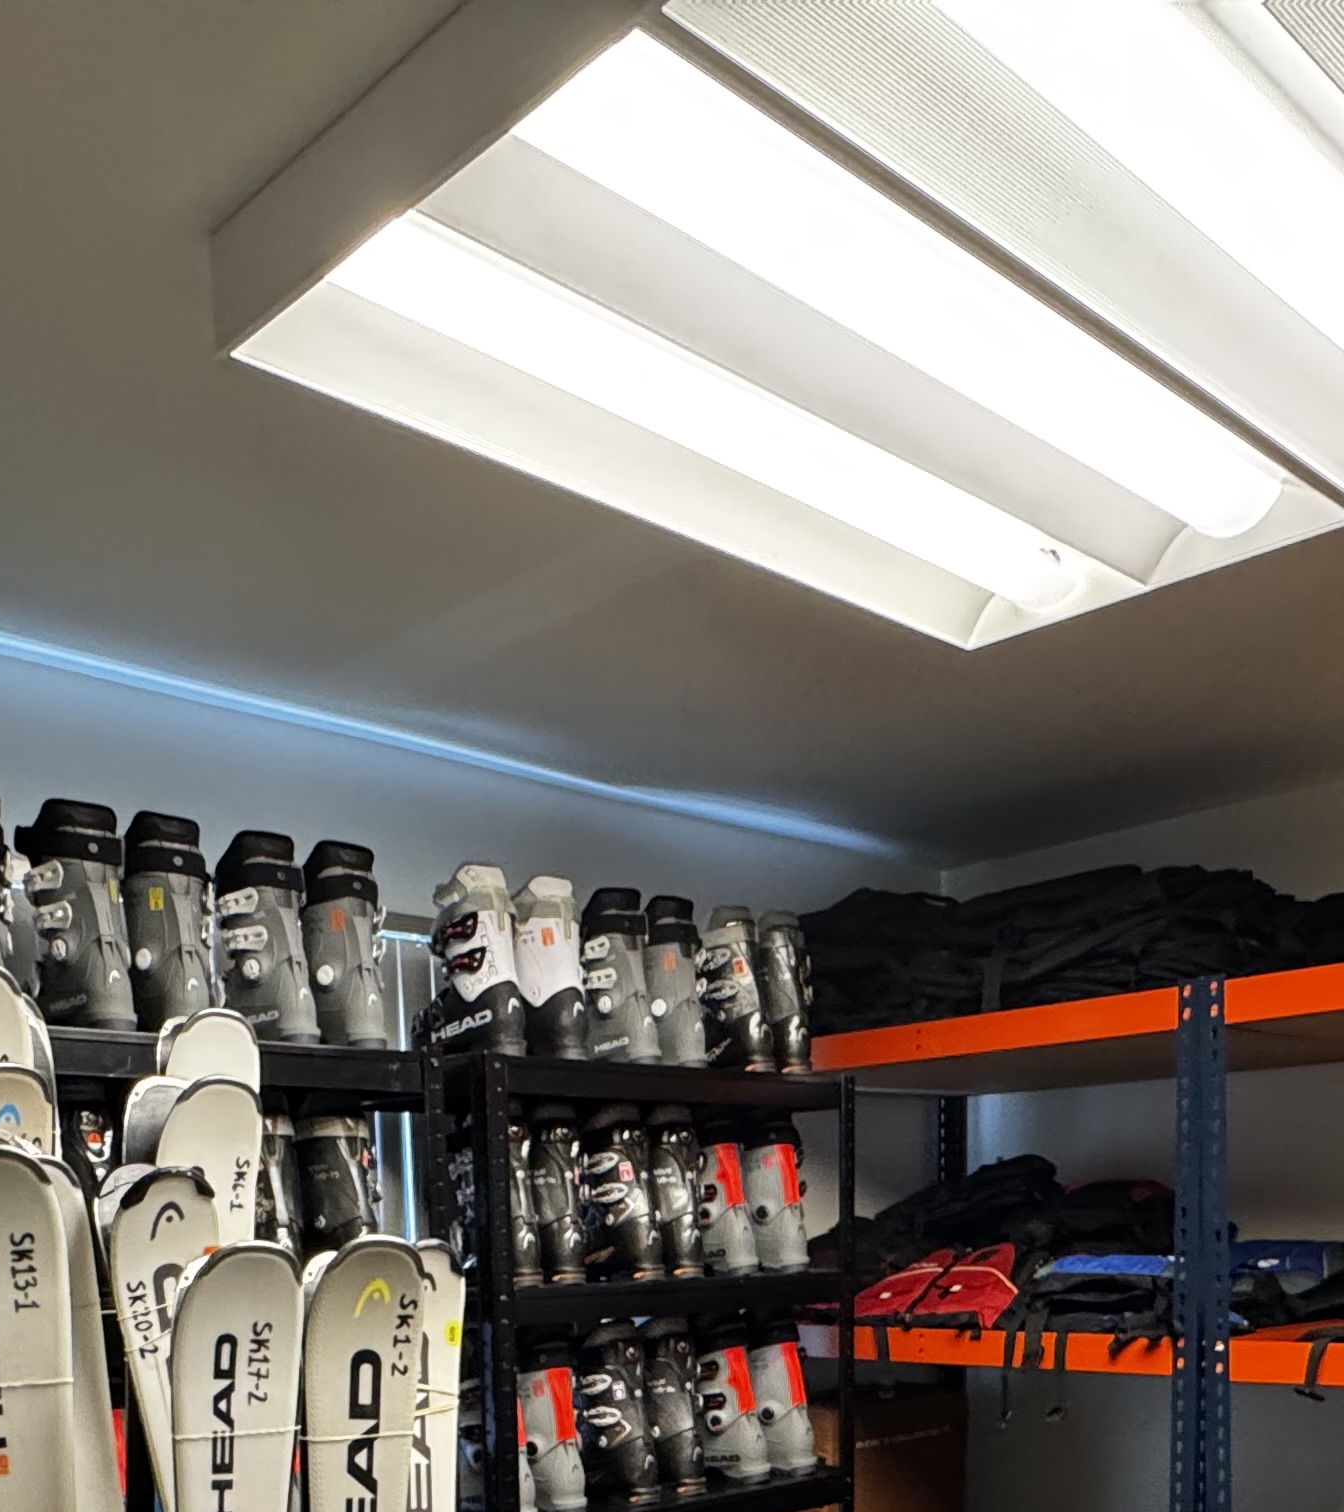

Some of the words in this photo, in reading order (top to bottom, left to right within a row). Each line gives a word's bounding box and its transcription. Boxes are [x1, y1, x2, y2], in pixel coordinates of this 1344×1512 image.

[245, 1009, 280, 1025] EAD
[430, 1008, 493, 1044] HEAD
[593, 1035, 630, 1054] HEAD
[9, 1231, 41, 1314] SK13-1
[390, 1292, 419, 1378] SK1-2
